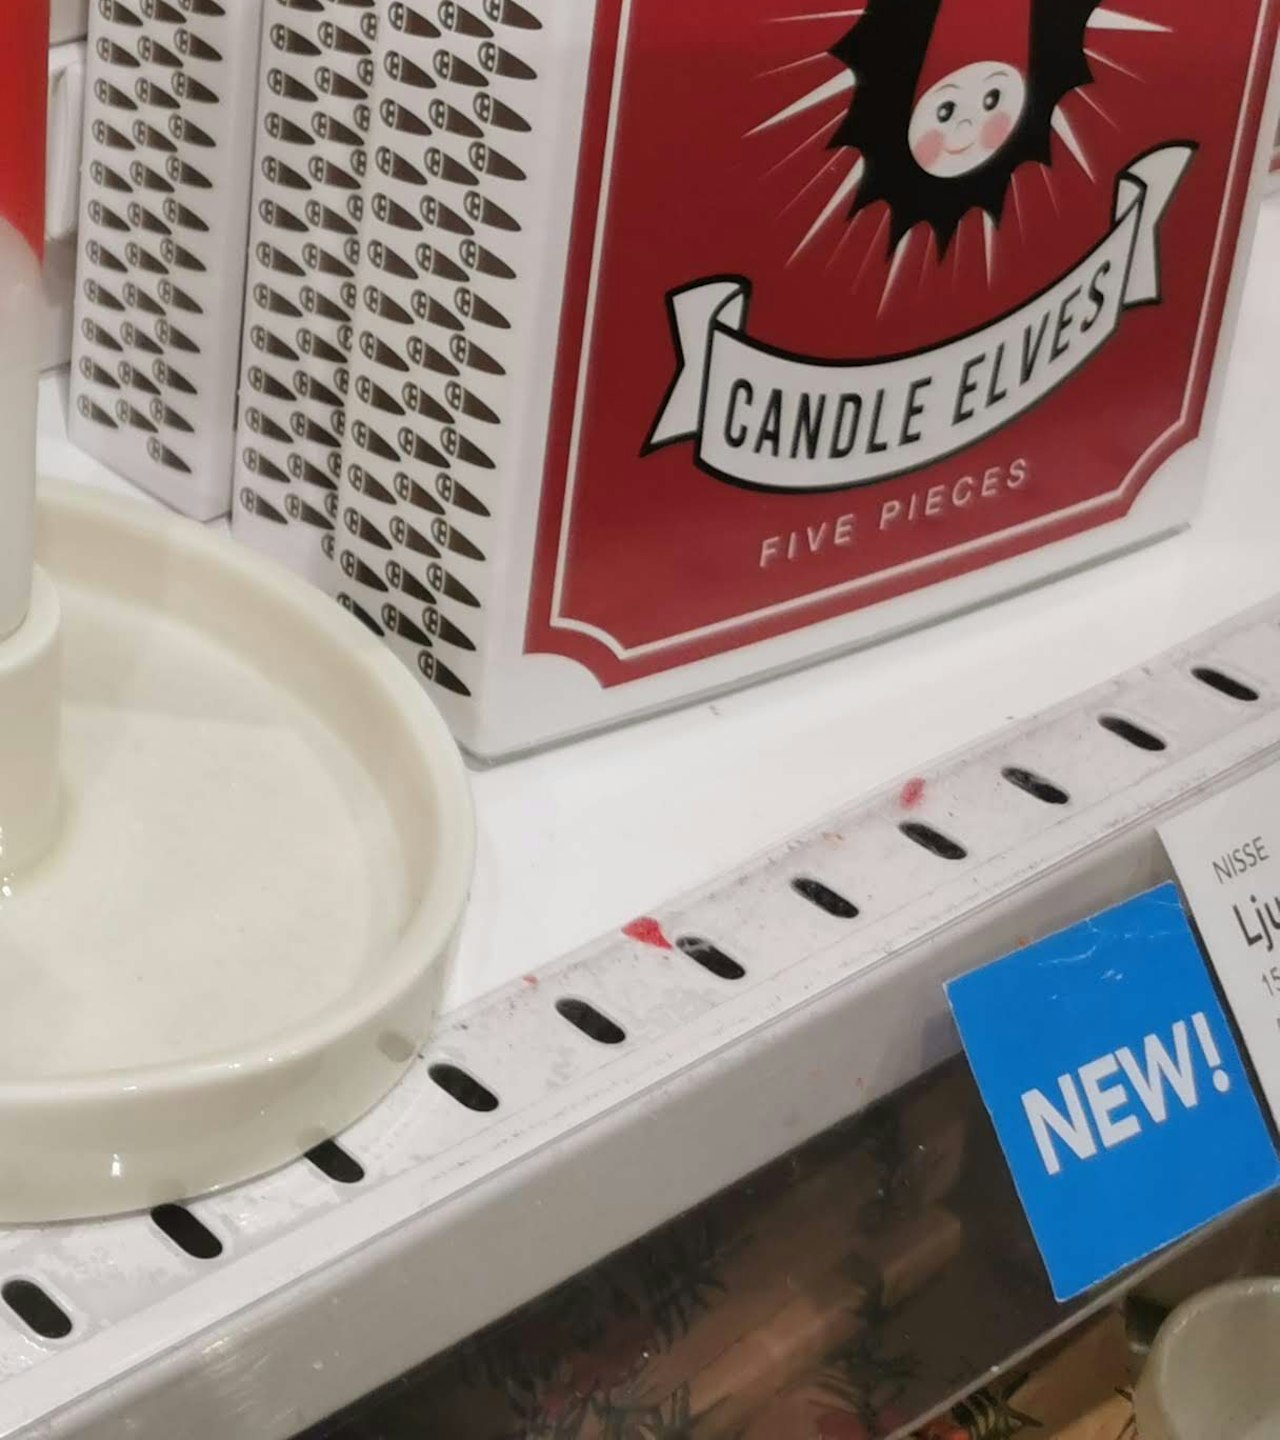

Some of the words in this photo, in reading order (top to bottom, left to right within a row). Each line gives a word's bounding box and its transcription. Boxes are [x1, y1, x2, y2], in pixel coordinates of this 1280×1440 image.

[723, 376, 933, 461] CANDLE
[950, 259, 1114, 428] ELVES
[758, 513, 857, 567] FIVE
[878, 457, 1030, 531] PIECES
[1211, 835, 1270, 885] NISSE
[1020, 1011, 1231, 1177] NEW!
